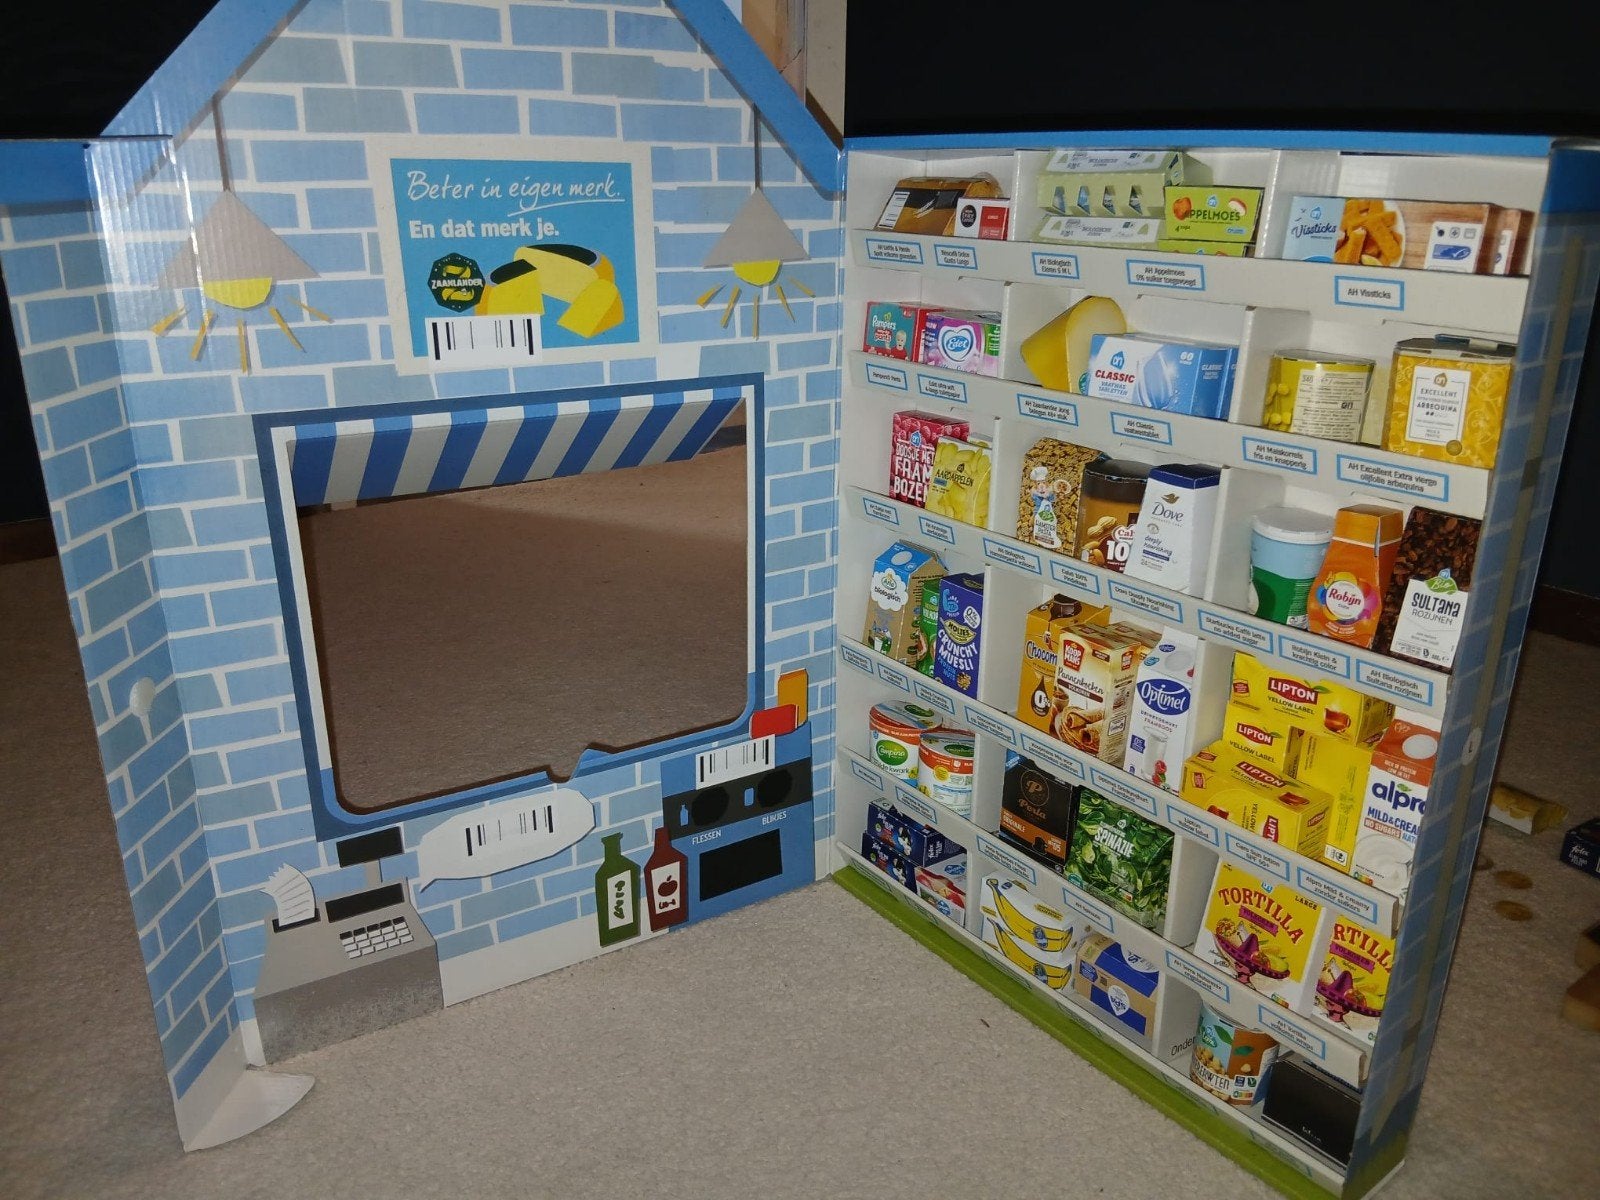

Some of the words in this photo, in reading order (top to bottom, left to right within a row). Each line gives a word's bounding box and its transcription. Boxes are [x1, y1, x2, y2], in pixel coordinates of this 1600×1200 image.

[408, 170, 475, 201] Beter
[481, 178, 502, 198] in
[509, 176, 564, 212] eigen
[1184, 208, 1241, 221] APPELMOES
[409, 220, 435, 238] En
[442, 218, 476, 238] dat
[481, 218, 532, 237] merk
[536, 216, 560, 241] je.
[1290, 222, 1337, 239] Vissticks
[431, 278, 484, 290] ZAANLANDER
[1347, 288, 1358, 296] AH
[1360, 288, 1392, 299] Vissticks
[1095, 369, 1136, 384] CLASSIC
[936, 469, 974, 487] AARDAPPELEN
[1348, 462, 1360, 471] AH
[1361, 464, 1392, 478] Excellent
[1393, 469, 1413, 481] Extra
[1414, 474, 1438, 488] vierge
[1387, 478, 1424, 494] arbequina
[1151, 502, 1184, 523] Dove
[1106, 540, 1130, 562] 10
[874, 586, 902, 602] biologisch
[1328, 588, 1362, 606] Robijn
[1412, 610, 1453, 626] ROZIJNEN
[938, 629, 978, 658] CRUNCHY
[1222, 628, 1238, 640] added
[1239, 634, 1259, 647] sugar
[938, 644, 974, 671] MUESLI
[1026, 640, 1058, 666] Chocom
[1292, 644, 1312, 658] Robijn
[1292, 651, 1319, 667] krachtig
[1366, 675, 1393, 690] Sultana
[1393, 682, 1423, 700] rozijnen
[1370, 668, 1382, 678] AH
[1382, 672, 1418, 690] Biologisch
[1140, 681, 1186, 712] Optimel
[1270, 679, 1316, 703] LIPTON
[1268, 696, 1294, 708] YELLOW
[1294, 704, 1316, 715] LABEL
[1238, 725, 1272, 745] LIPTON
[1229, 740, 1254, 757] YELLOW
[1254, 750, 1276, 764] LABEL
[1238, 762, 1284, 787] LIPTON
[762, 810, 787, 826] BLIKJES
[1018, 798, 1046, 820] Perla
[692, 830, 722, 845] FLESSEN
[1095, 826, 1134, 858] SPINAZIE
[1375, 822, 1400, 838] SUGARS
[1402, 831, 1416, 844] NAT
[1305, 875, 1321, 889] Alpro
[1294, 894, 1318, 911] LARGE
[1218, 887, 1304, 945] TORTILLA
[1334, 922, 1392, 974] RTILL
[1171, 1036, 1197, 1056] Onder
